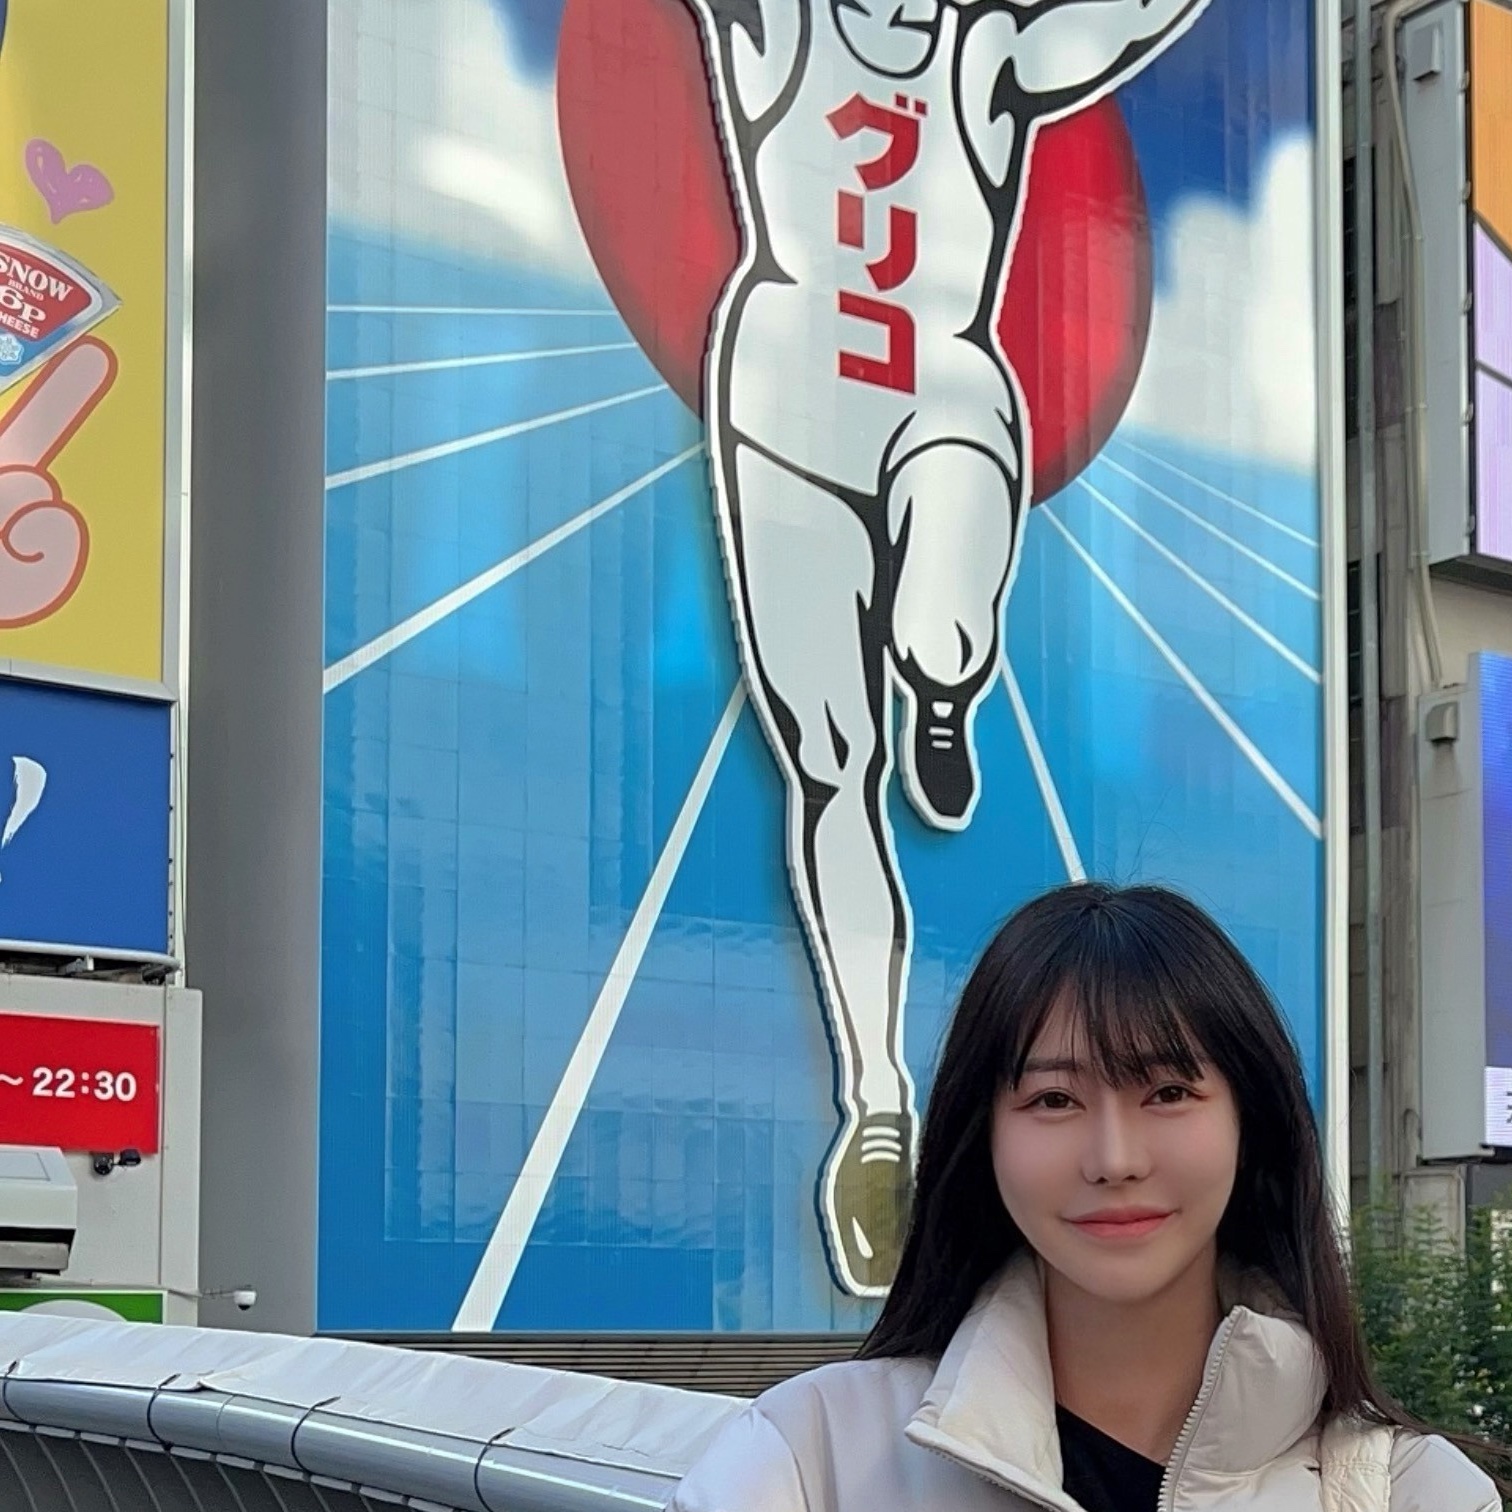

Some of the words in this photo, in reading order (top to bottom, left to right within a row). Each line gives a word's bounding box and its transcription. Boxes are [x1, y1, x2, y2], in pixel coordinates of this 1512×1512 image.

[0, 285, 47, 324] 6P
[825, 92, 928, 396] グリコ
